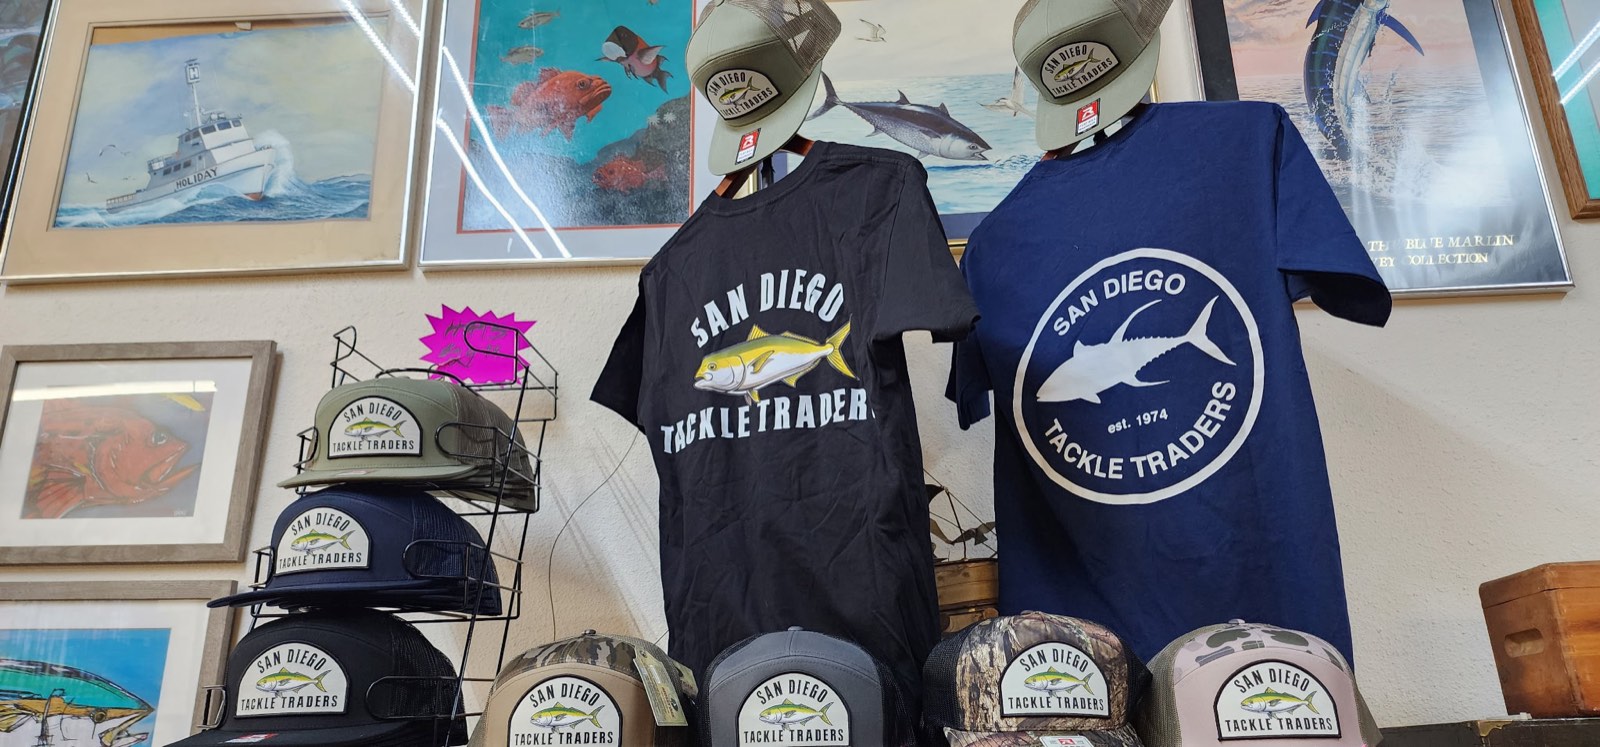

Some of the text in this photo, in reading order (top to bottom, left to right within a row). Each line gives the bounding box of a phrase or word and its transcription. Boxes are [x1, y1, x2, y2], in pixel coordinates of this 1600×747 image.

[1045, 44, 1087, 74] SAN DIEGO
[709, 72, 746, 96] SAN DIEGO
[1052, 58, 1113, 95] TACKLE TRADERS
[720, 87, 773, 117] TACKLE TRADERS
[176, 167, 218, 189] HOLIDAY
[1368, 240, 1400, 252] TH
[1448, 235, 1515, 248] MARLIN
[1401, 253, 1488, 266] OLLECTION
[690, 268, 844, 348] SAN DIEGO
[1053, 269, 1186, 337] SAN DIEGO
[343, 402, 402, 422] SAN DIEGO
[660, 388, 876, 454] TACKLE TRADER
[1107, 408, 1168, 434] est. 1974
[1044, 381, 1237, 479] TACKLE TRADERS
[333, 440, 414, 453] TACKLE TRADERS
[291, 512, 351, 536] SAN DIEGO
[279, 552, 362, 569] TACKLE TRADERS
[257, 648, 327, 674] SAN DIEGO
[1019, 648, 1088, 673] SAN DIEGO
[756, 679, 828, 705] SAN DIEGO
[1233, 668, 1310, 694] SAN DIEGO
[241, 695, 338, 711] TACKLE TRADERS
[529, 683, 600, 708] SAN DIEGO
[1008, 696, 1104, 711] TACKLE TRADERS
[744, 728, 844, 743] TACKLE TRADERS
[1225, 717, 1333, 732] TACKLE TRADERS
[514, 731, 614, 746] TACKLE TRADERS
